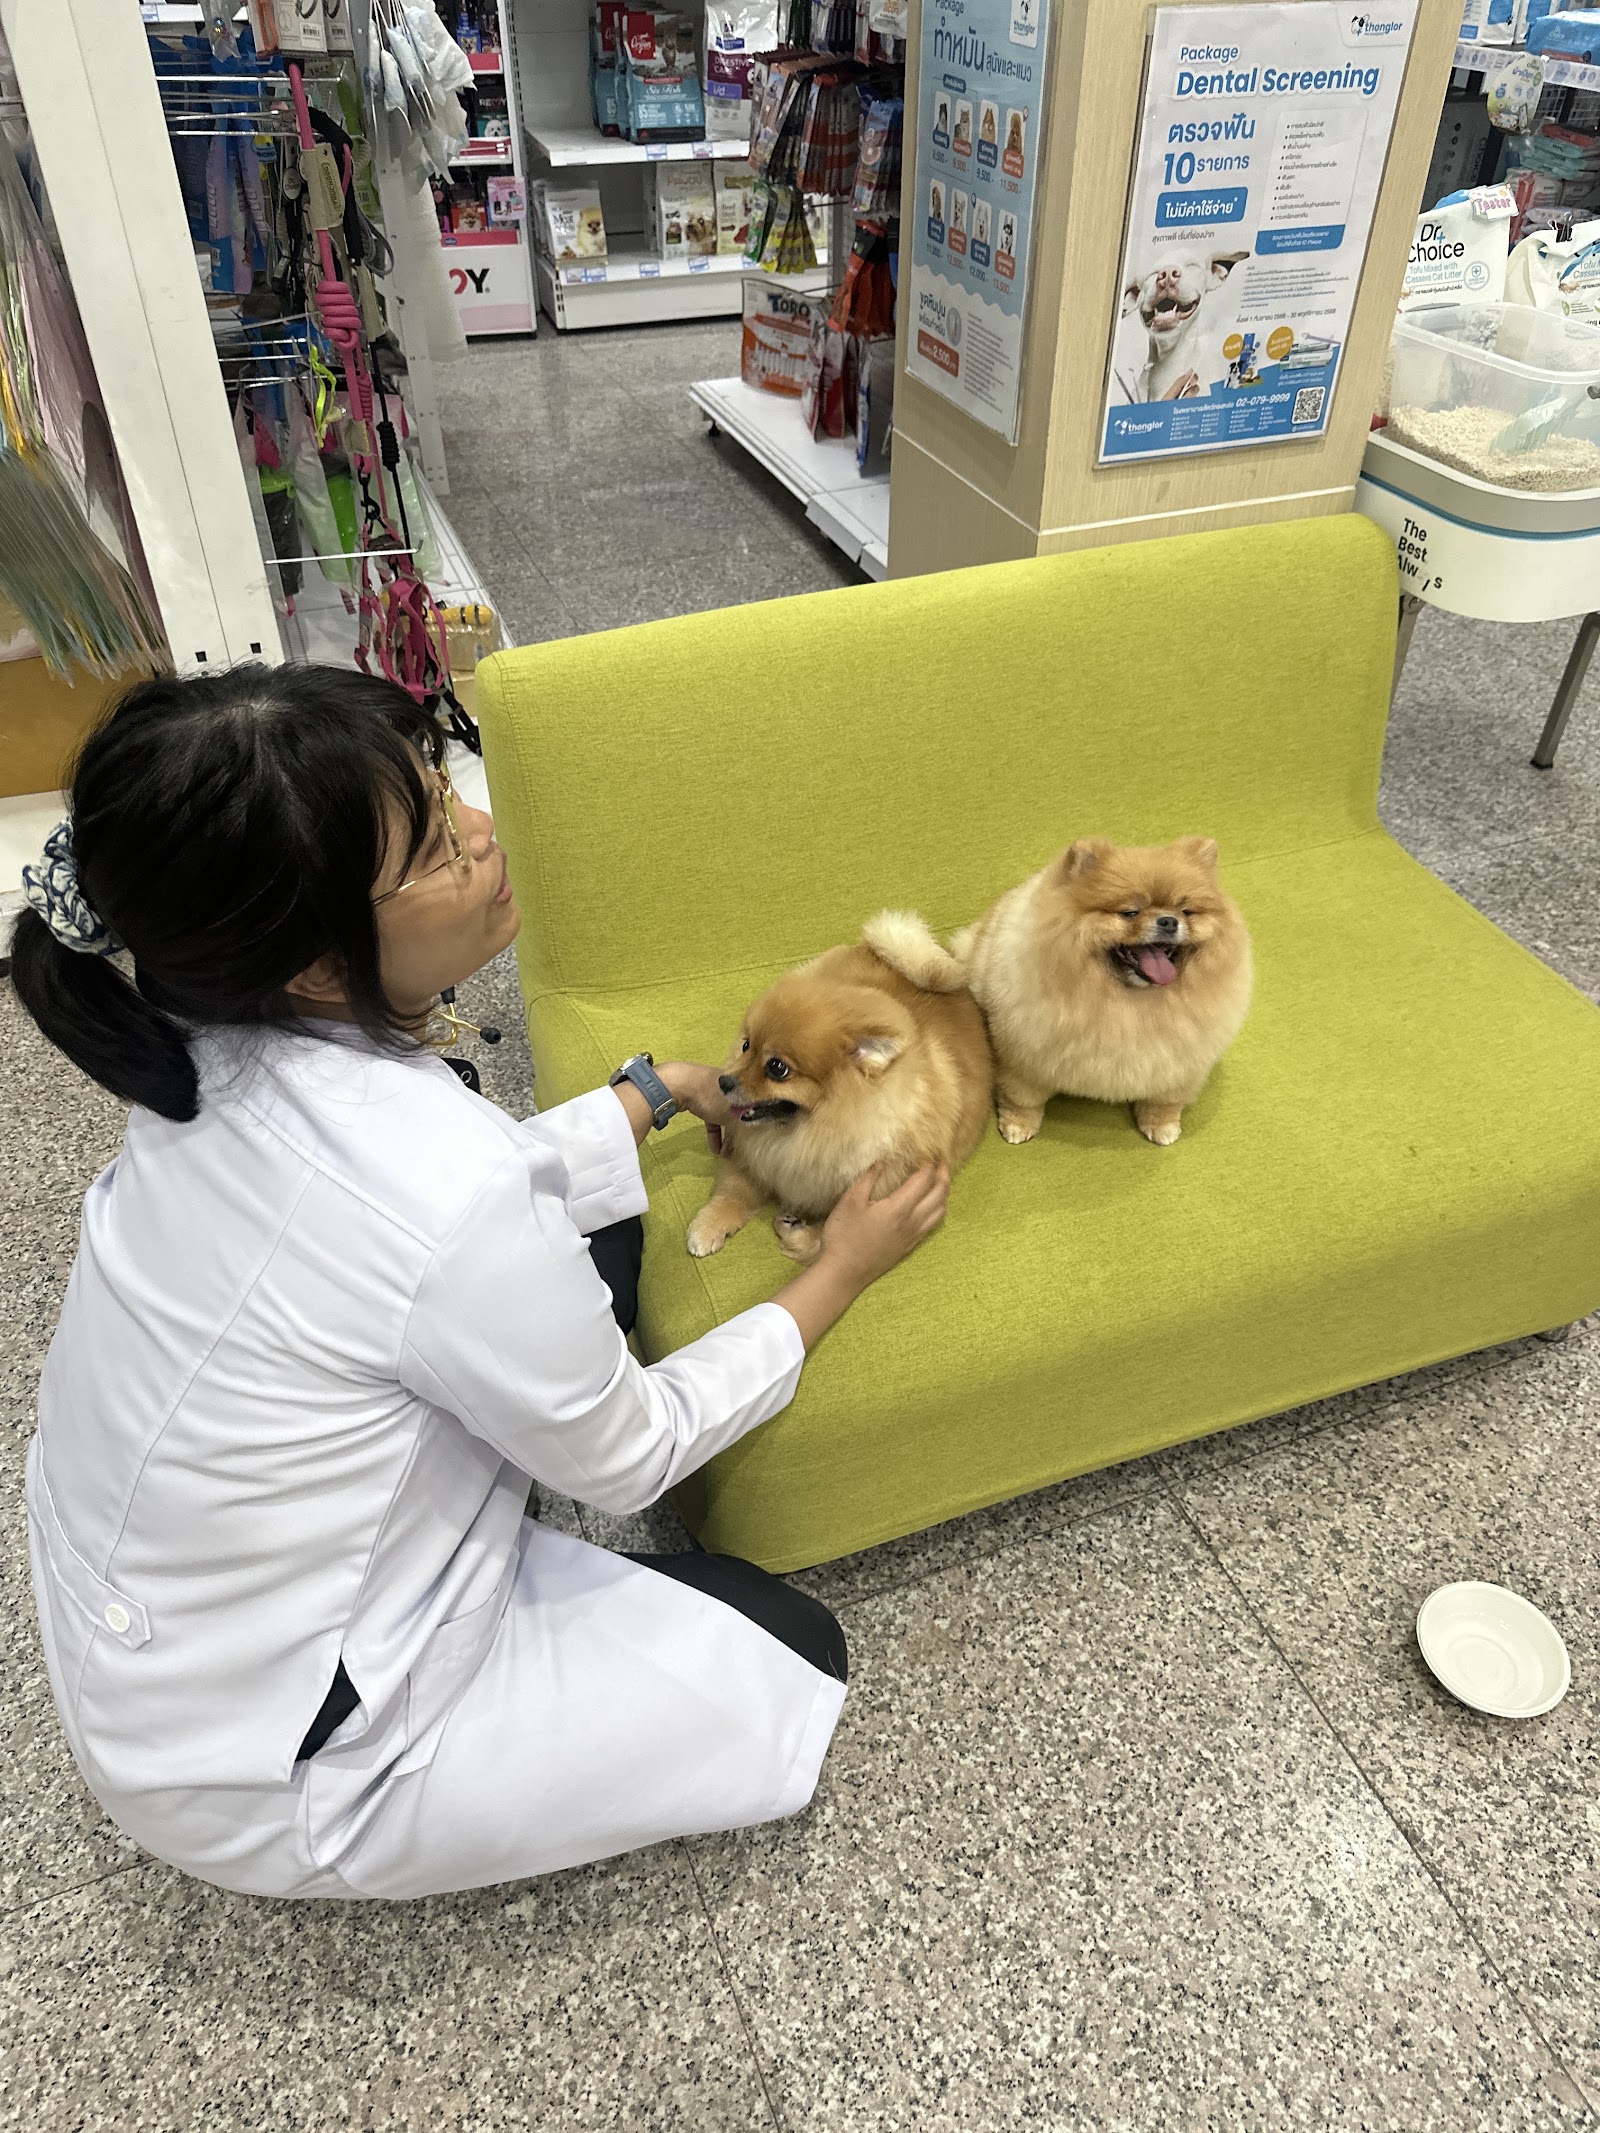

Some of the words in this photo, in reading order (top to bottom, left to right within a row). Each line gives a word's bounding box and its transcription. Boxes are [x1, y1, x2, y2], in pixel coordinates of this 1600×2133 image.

[1364, 20, 1403, 35] thonglor
[934, 15, 985, 72] ทำหมัน
[986, 51, 1032, 82] สุนัขและแมว
[1180, 46, 1238, 63] Package
[1177, 67, 1258, 96] Dental
[1262, 62, 1380, 95] Screening
[1168, 112, 1256, 143] ตรวจฟัน
[1164, 151, 1196, 186] 10
[1196, 155, 1250, 172] รายการ
[1475, 198, 1511, 211] Tester
[1421, 223, 1442, 242] Dr
[1409, 266, 1424, 276] Tofu
[1424, 264, 1442, 273] Mixed
[1443, 262, 1458, 271] with
[1432, 272, 1444, 281] Cat
[1444, 270, 1463, 280] Litter
[1235, 392, 1291, 408] 02-079-9999
[1128, 420, 1164, 433] thonglor
[1404, 517, 1427, 542] The
[1398, 535, 1428, 563] Best
